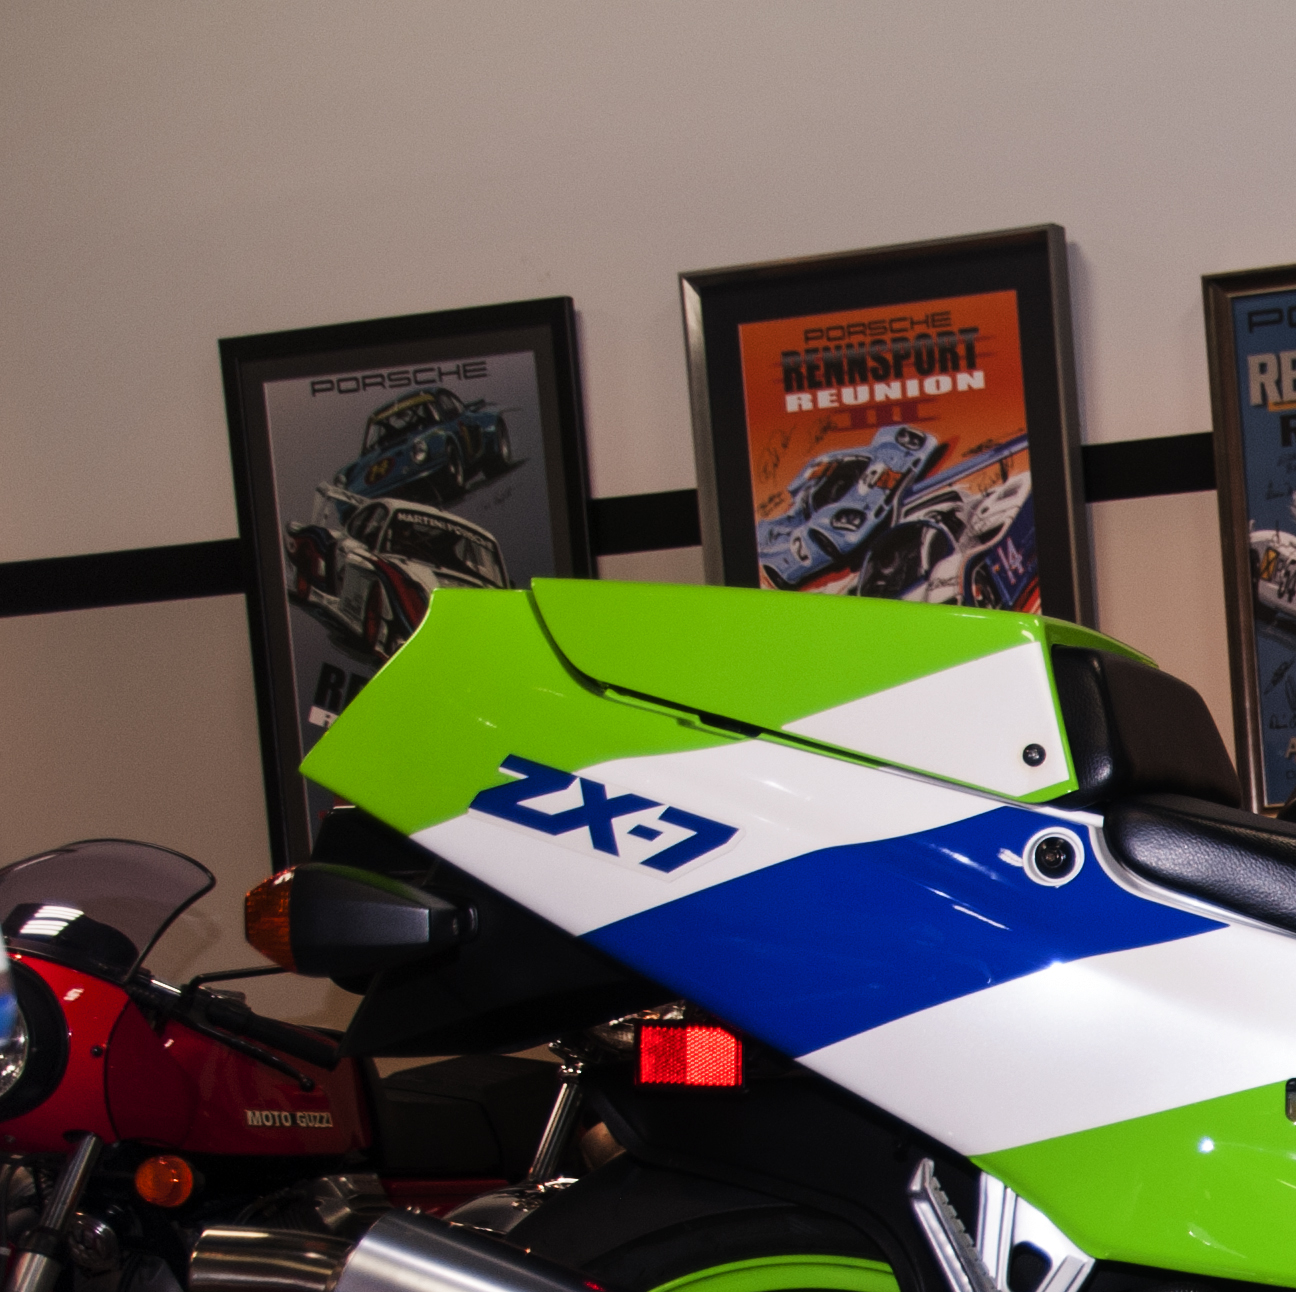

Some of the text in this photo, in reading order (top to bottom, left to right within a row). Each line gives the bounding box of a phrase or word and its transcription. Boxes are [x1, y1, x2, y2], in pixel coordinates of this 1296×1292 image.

[804, 311, 953, 345] PORSCHE
[310, 360, 488, 397] PORSCHE
[781, 327, 980, 392] RENNSPORT
[785, 370, 985, 413] REUNION
[997, 537, 1025, 586] 14
[468, 753, 739, 874] ZX-7
[245, 1110, 292, 1127] MOTO
